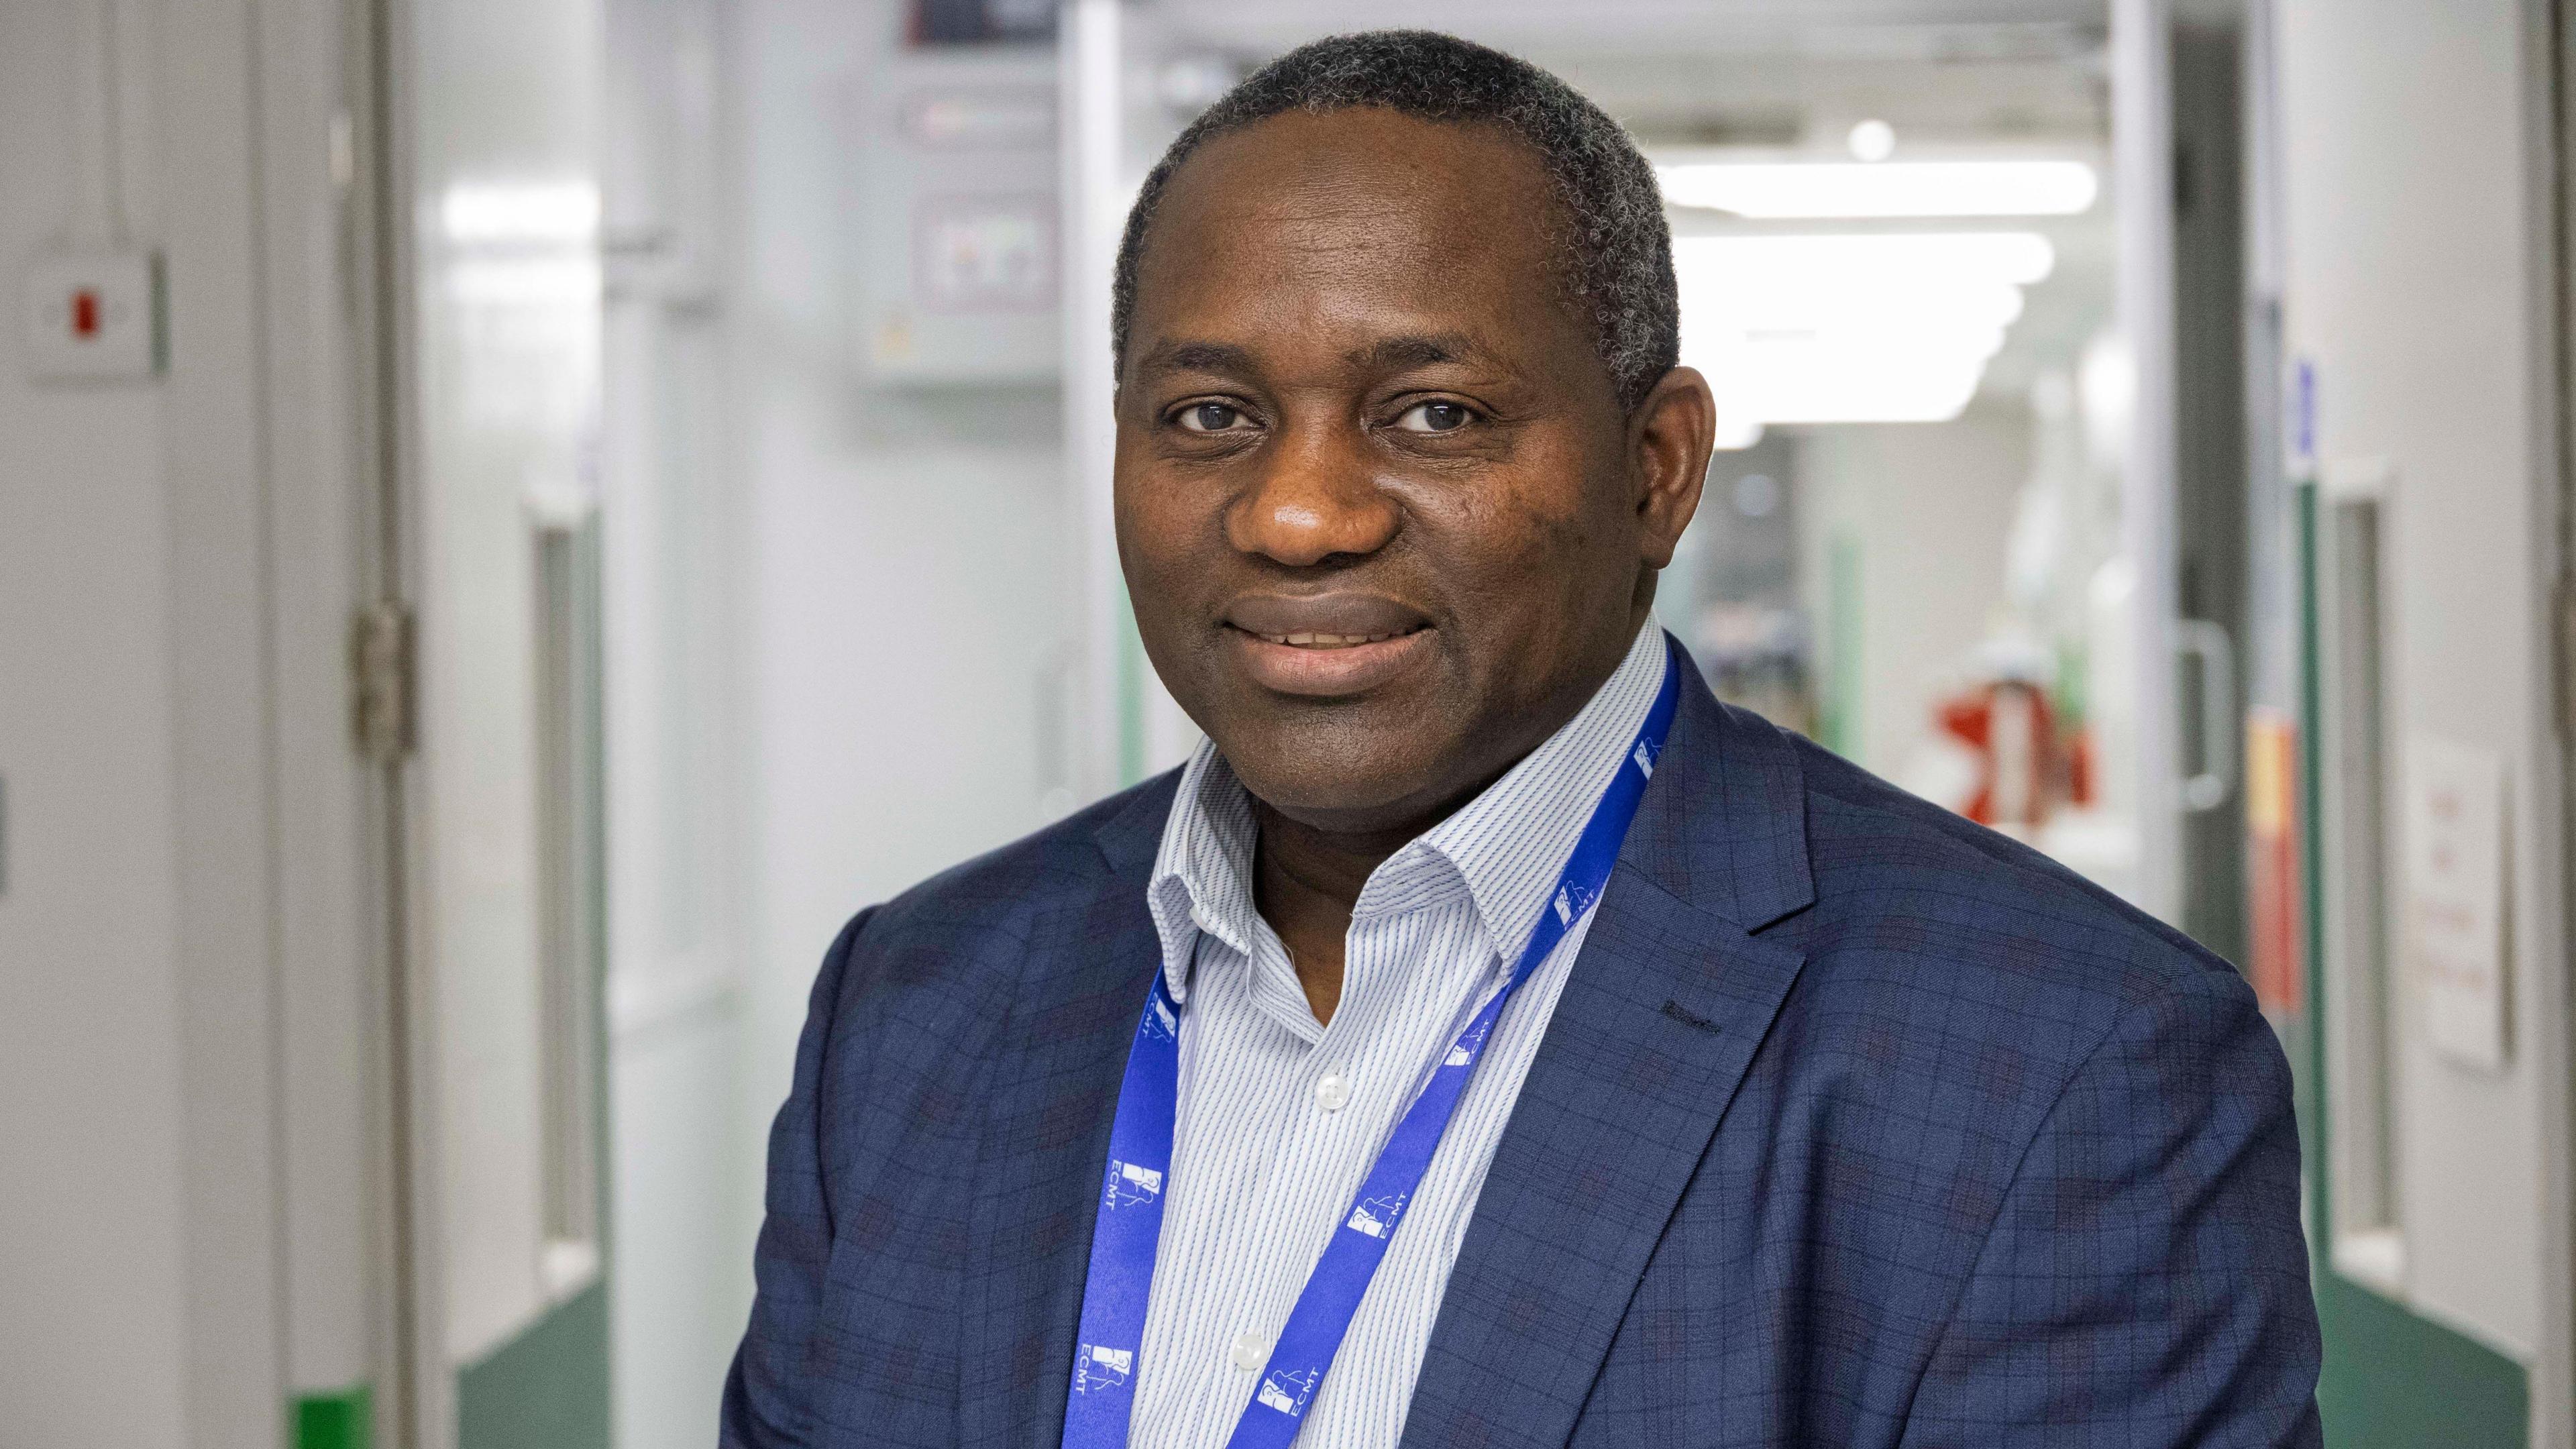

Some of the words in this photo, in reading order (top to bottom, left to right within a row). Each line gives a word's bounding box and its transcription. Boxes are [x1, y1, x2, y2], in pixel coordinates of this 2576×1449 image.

[1142, 992, 1159, 1038] ECMT
[1106, 1159, 1122, 1210] ECMT
[1379, 1191, 1406, 1240] ECMT
[1075, 1344, 1091, 1395] ECMT
[1290, 1366, 1319, 1417] ECMT
